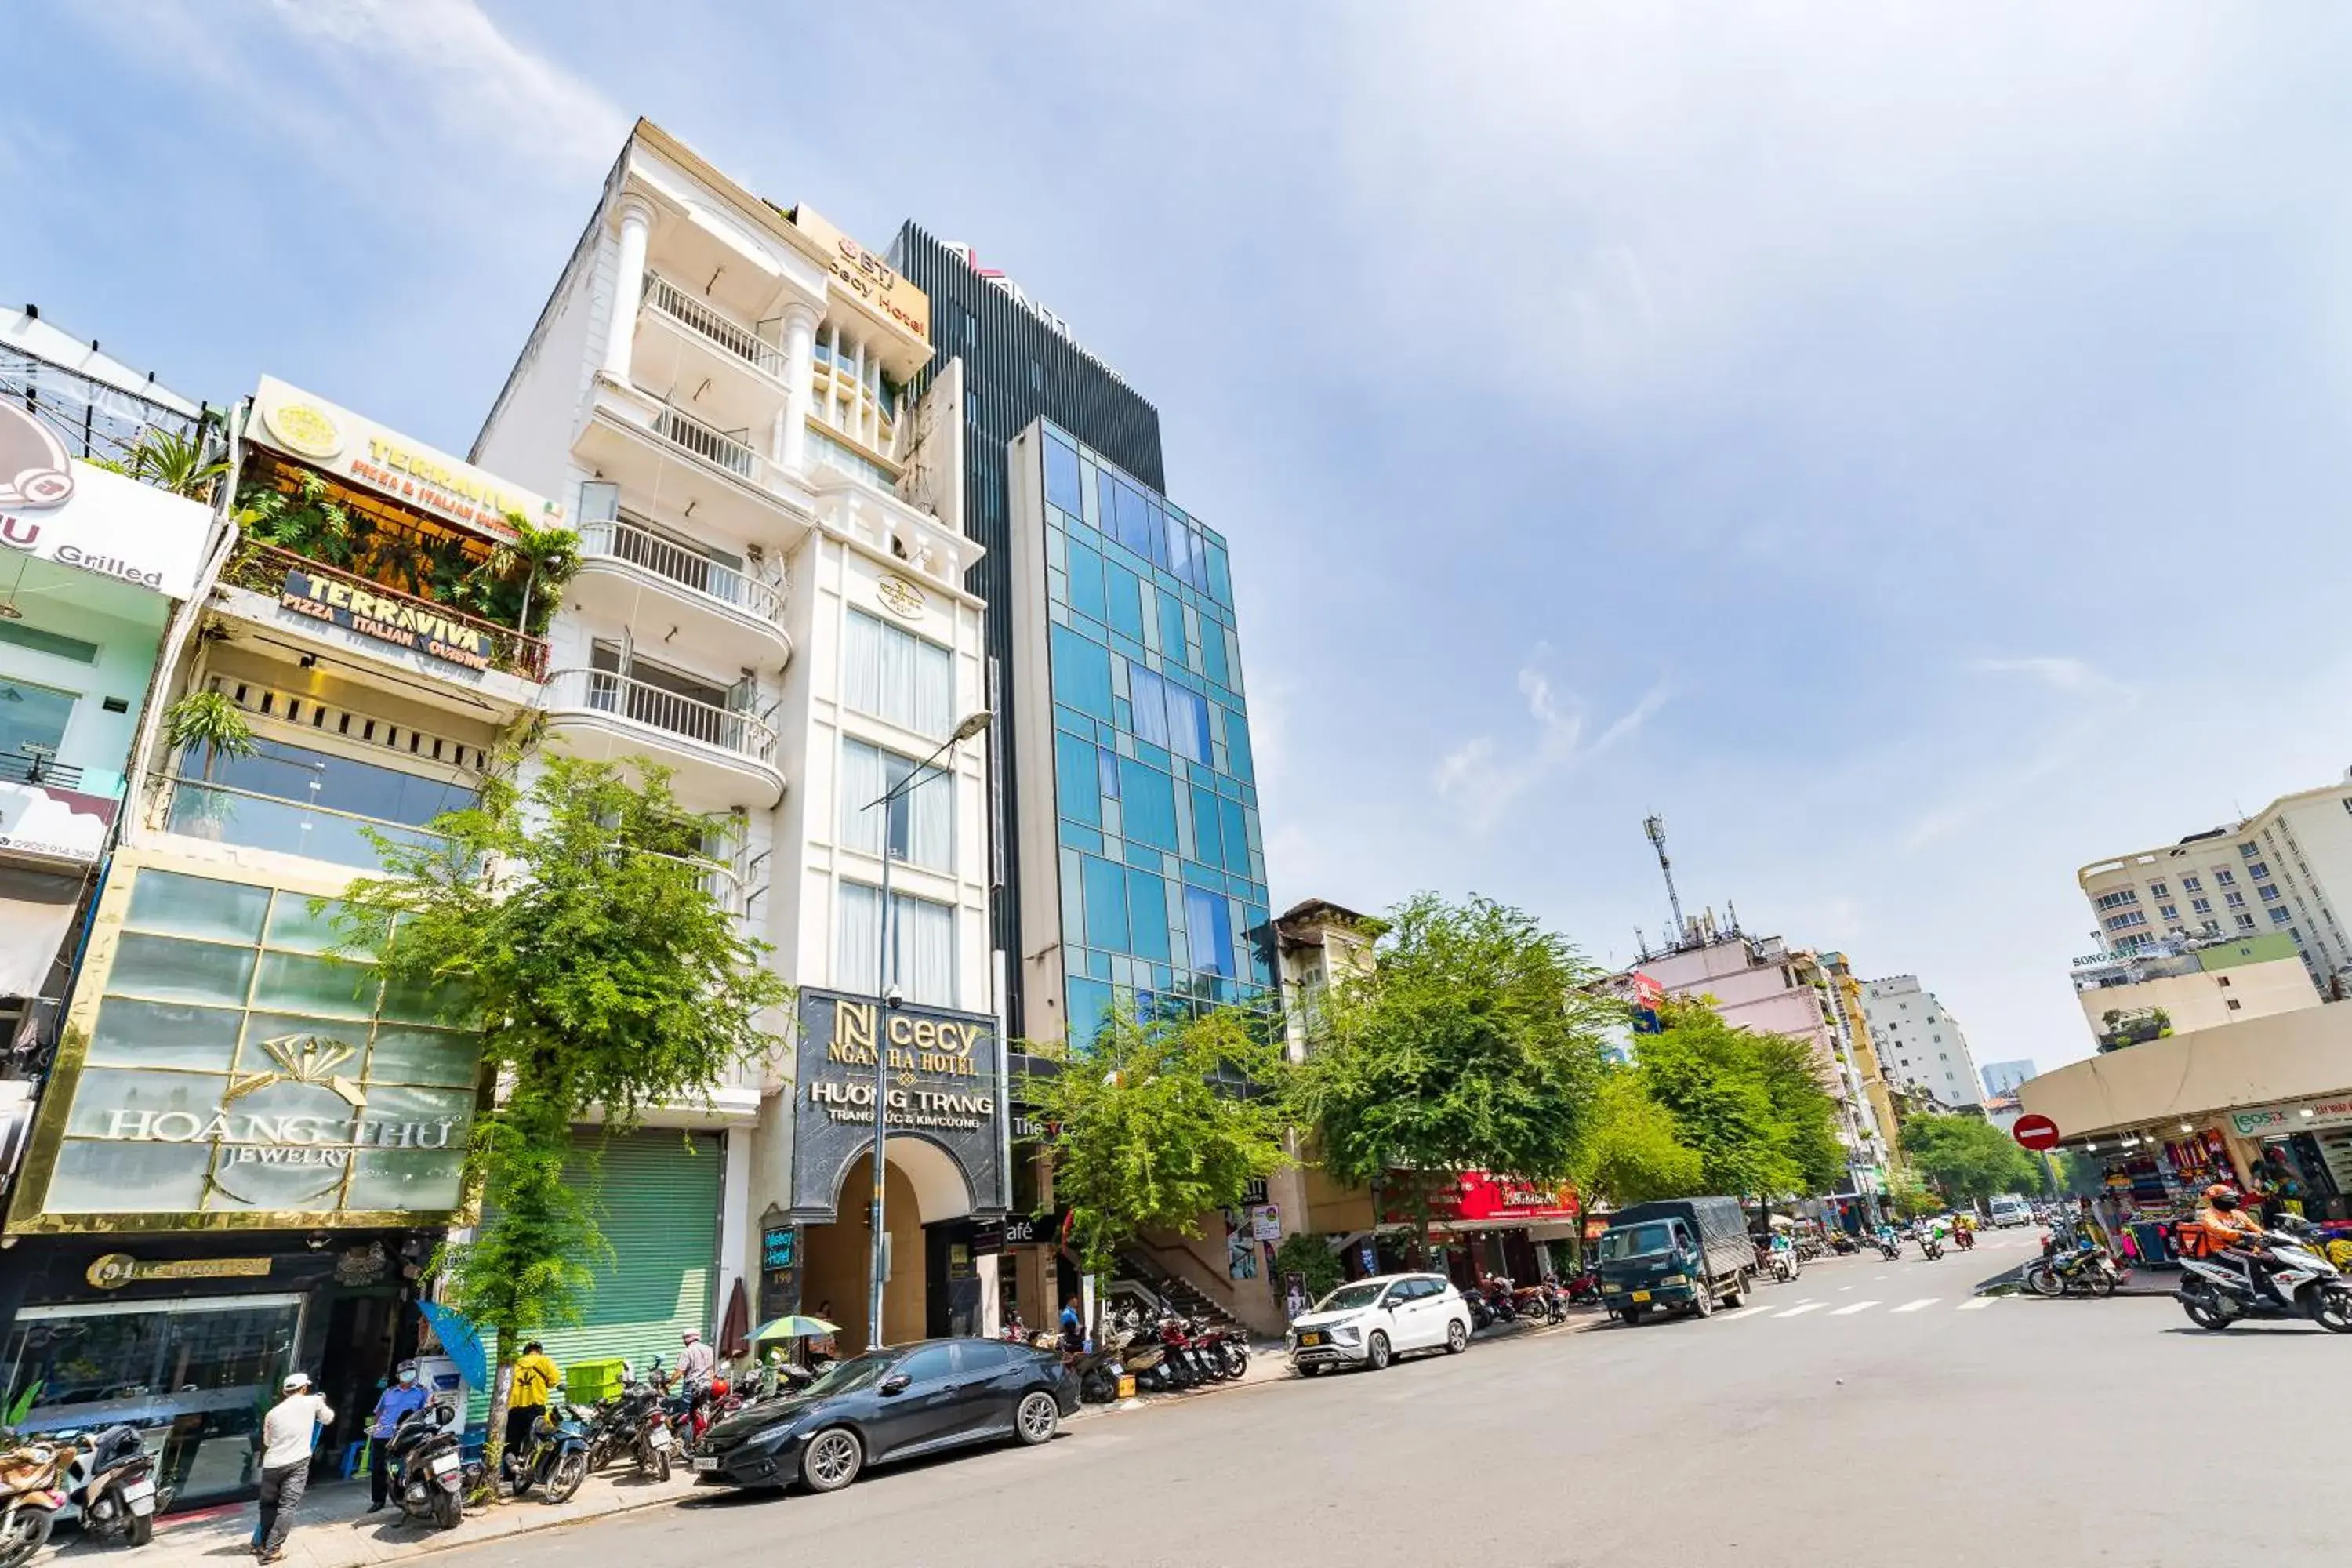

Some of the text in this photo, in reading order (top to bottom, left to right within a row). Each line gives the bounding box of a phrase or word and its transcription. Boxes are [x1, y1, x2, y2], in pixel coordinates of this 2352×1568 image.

[879, 295, 924, 336] Hotel
[352, 459, 398, 491] PIZZA
[418, 487, 475, 521] ITALIAN
[56, 544, 164, 586] Grilled
[281, 593, 335, 622] PIZZA
[352, 614, 414, 648] ITALIAN
[307, 572, 481, 653] TERRAVIVA
[2072, 953, 2107, 967] SONG
[919, 1053, 979, 1076] HOTEL
[829, 1109, 875, 1123] TRANG
[916, 1115, 939, 1127] KIM
[913, 1091, 994, 1115] TRANG
[108, 1105, 323, 1145] HOÀNG
[220, 1146, 351, 1172] JEWELRY
[1006, 1222, 1033, 1240] afé
